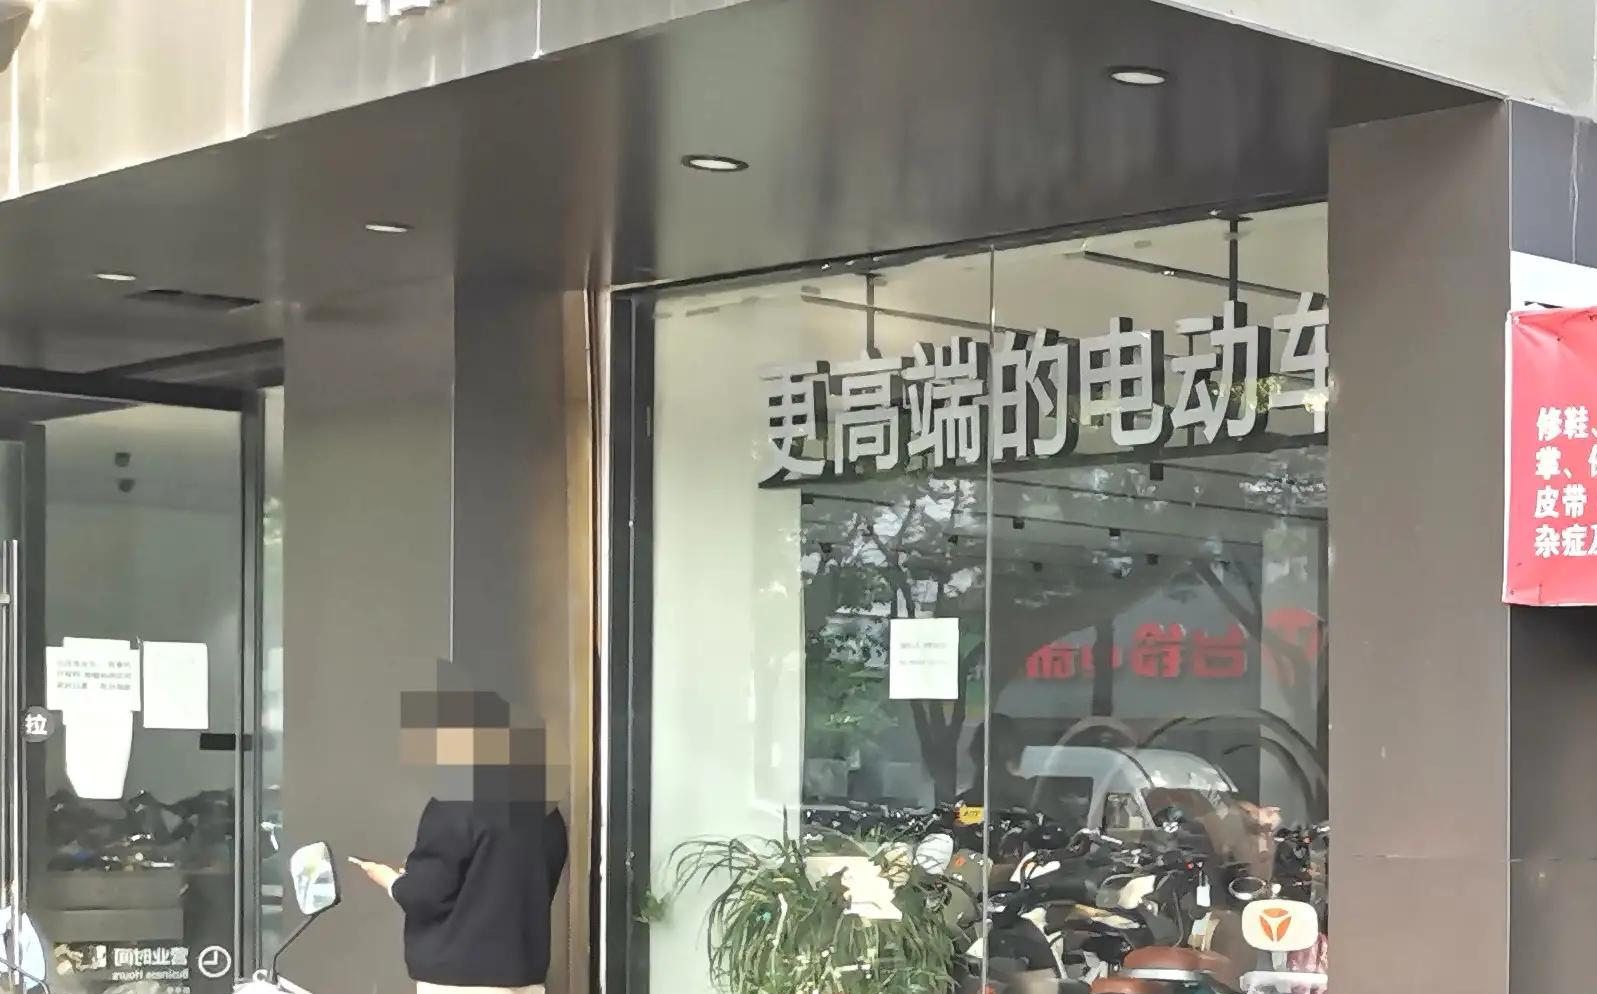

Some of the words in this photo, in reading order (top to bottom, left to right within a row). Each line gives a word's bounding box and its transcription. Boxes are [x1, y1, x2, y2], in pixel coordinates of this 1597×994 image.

[760, 293, 1329, 482] 更高端的电动车
[25, 713, 48, 735] 拉
